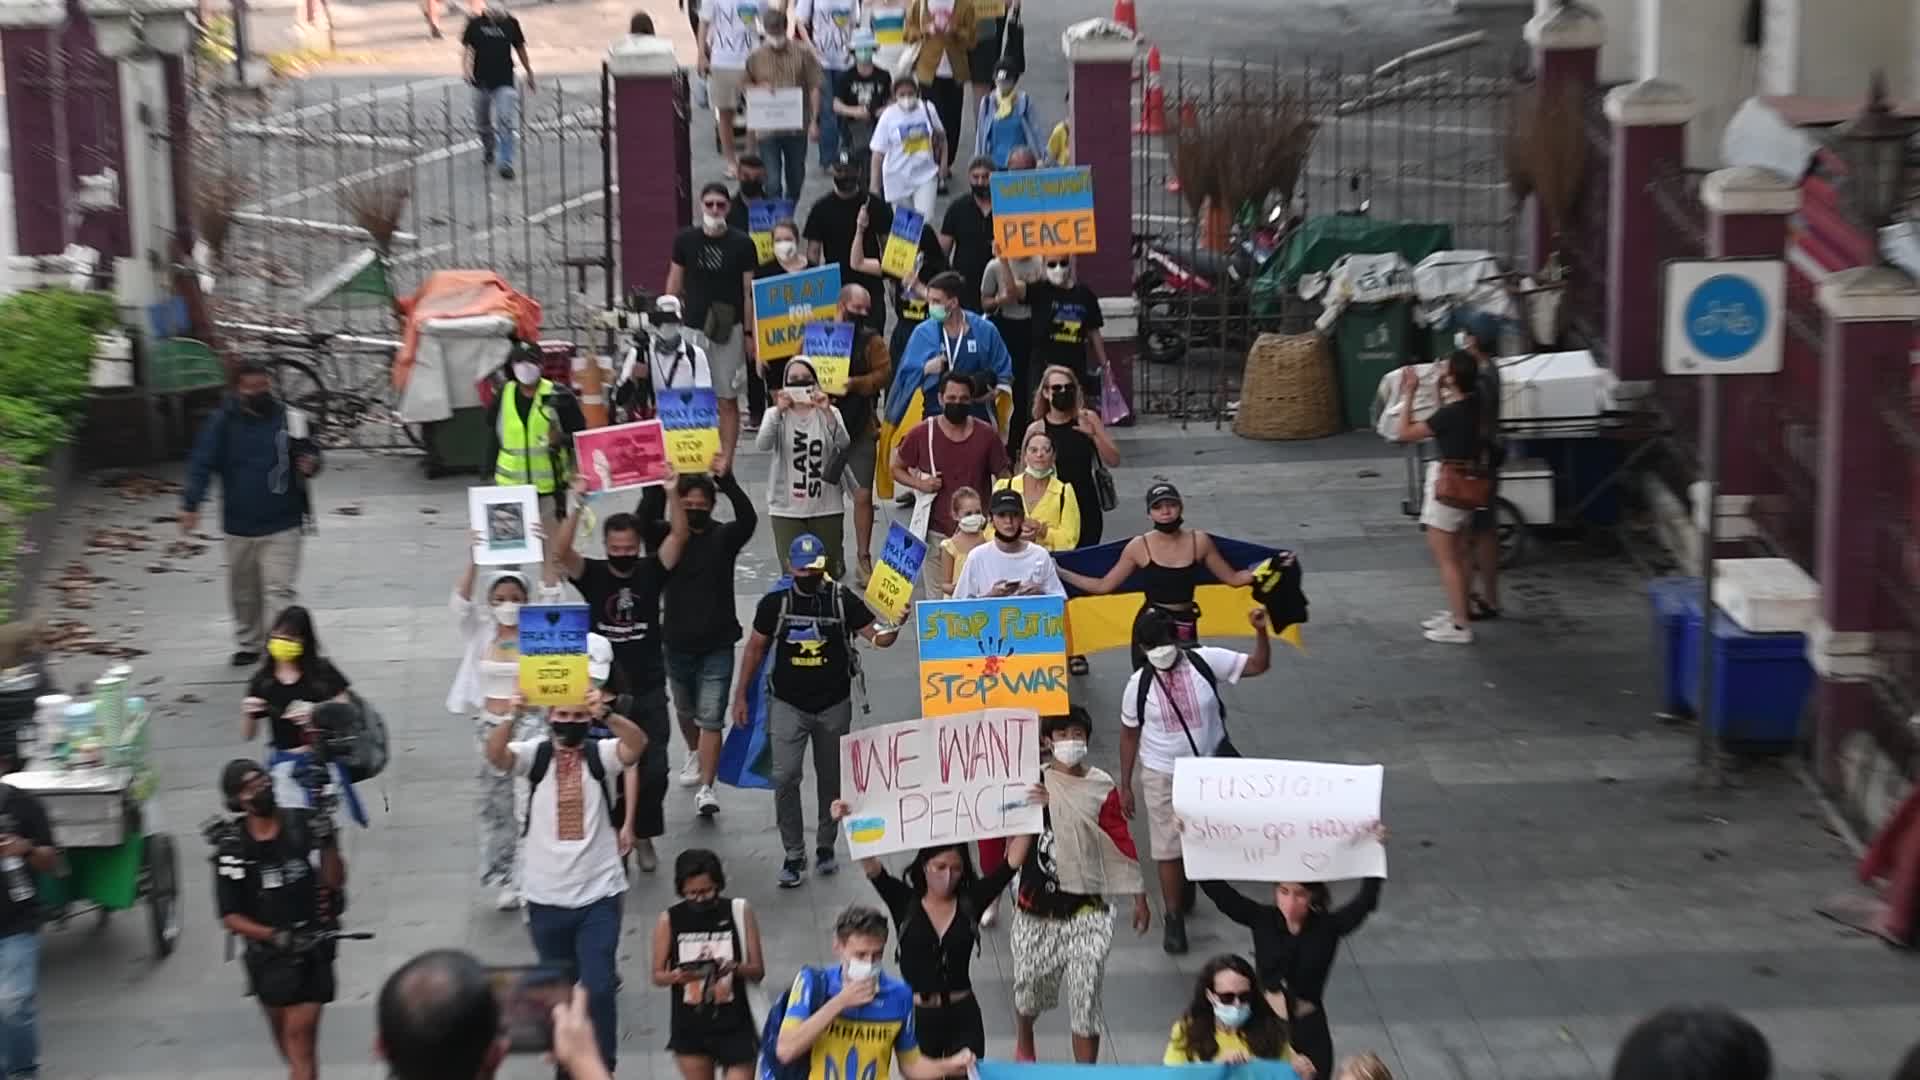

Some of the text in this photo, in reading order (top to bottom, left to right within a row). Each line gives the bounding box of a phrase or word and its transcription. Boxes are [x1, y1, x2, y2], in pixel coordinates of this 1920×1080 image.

[1003, 217, 1091, 249] PEACE
[769, 279, 825, 305] PRAY
[788, 303, 814, 322] FOR
[674, 440, 703, 452] STOP
[677, 454, 703, 464] WAR
[808, 438, 823, 499] SKD
[881, 577, 900, 596] STOP
[877, 591, 895, 609] WAR
[921, 608, 989, 640] STOP
[521, 630, 584, 641] PRAY FOR
[537, 668, 569, 680] STOP
[538, 684, 569, 695] WAR
[925, 665, 1068, 705] STOP WAR
[850, 717, 1034, 794] WE WANT
[898, 782, 1029, 844] PEACE
